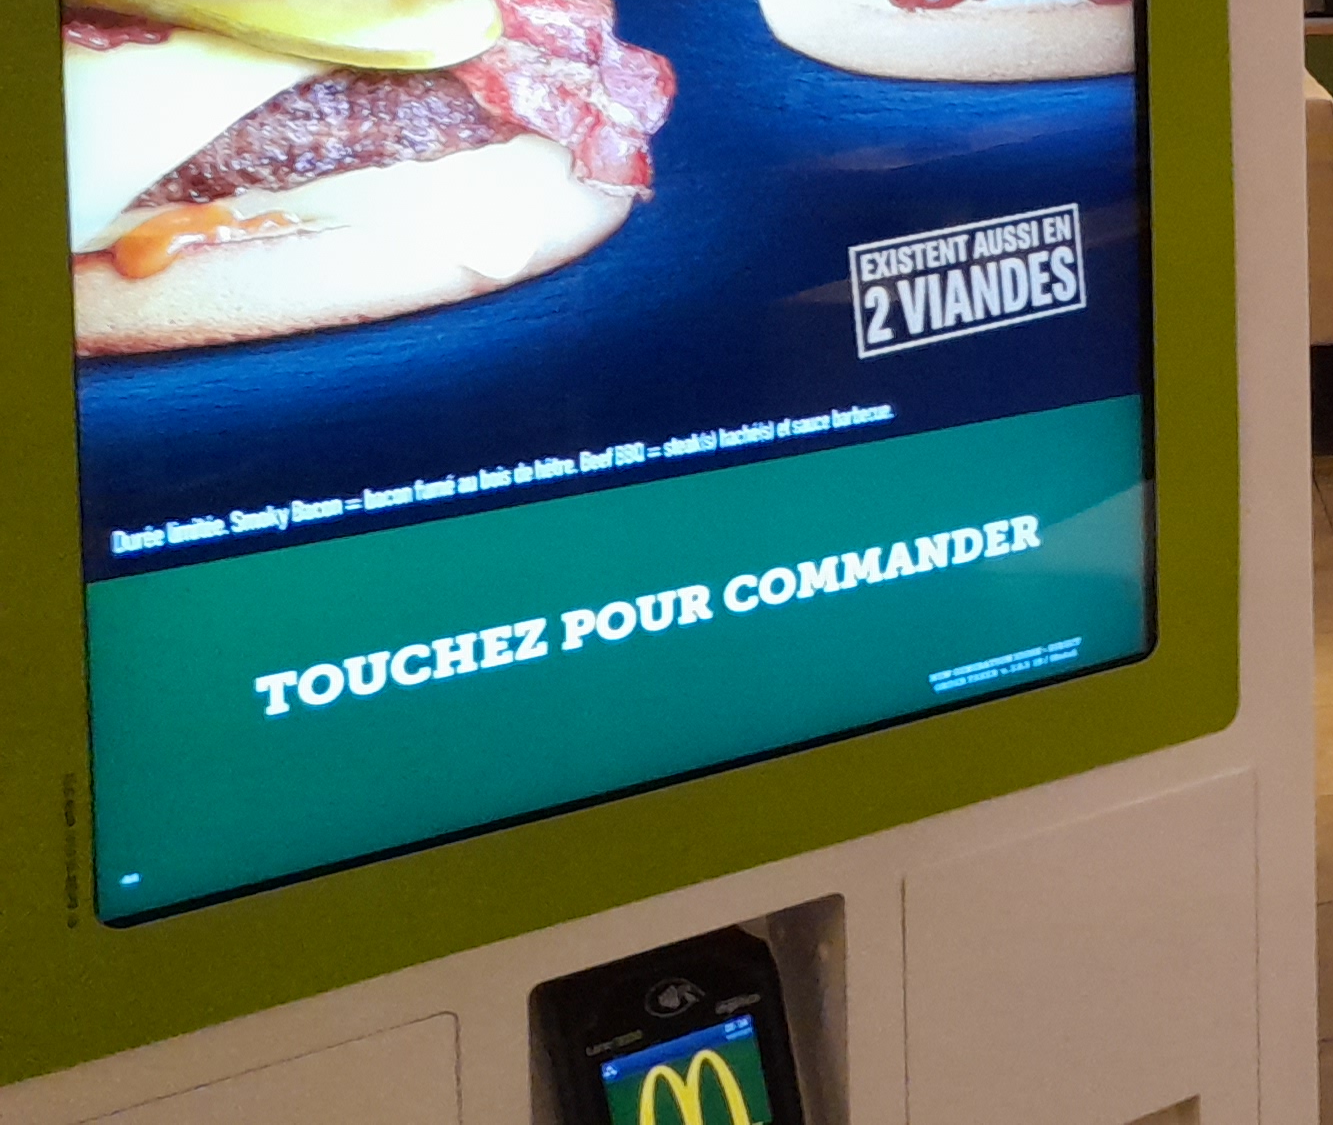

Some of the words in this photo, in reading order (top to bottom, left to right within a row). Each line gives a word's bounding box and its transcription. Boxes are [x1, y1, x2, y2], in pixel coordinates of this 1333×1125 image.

[861, 233, 969, 283] EXISTENT
[972, 219, 1039, 260] AUSSI
[1043, 214, 1073, 244] EN
[864, 285, 894, 344] 2
[897, 246, 1077, 335] VIANDES
[111, 526, 165, 554] Durée
[166, 515, 230, 543] limitée.
[230, 506, 290, 530] Smoky
[292, 499, 343, 522] Bacon
[364, 488, 413, 510] bacon
[457, 476, 478, 493] au
[479, 468, 512, 490] bois
[513, 462, 533, 484] de
[580, 447, 613, 472] Beef
[777, 418, 791, 438] et
[791, 415, 831, 435] sauce
[254, 617, 549, 717] TOUCHEZ
[562, 585, 713, 652] POUR
[723, 513, 1042, 613] COMMANDER
